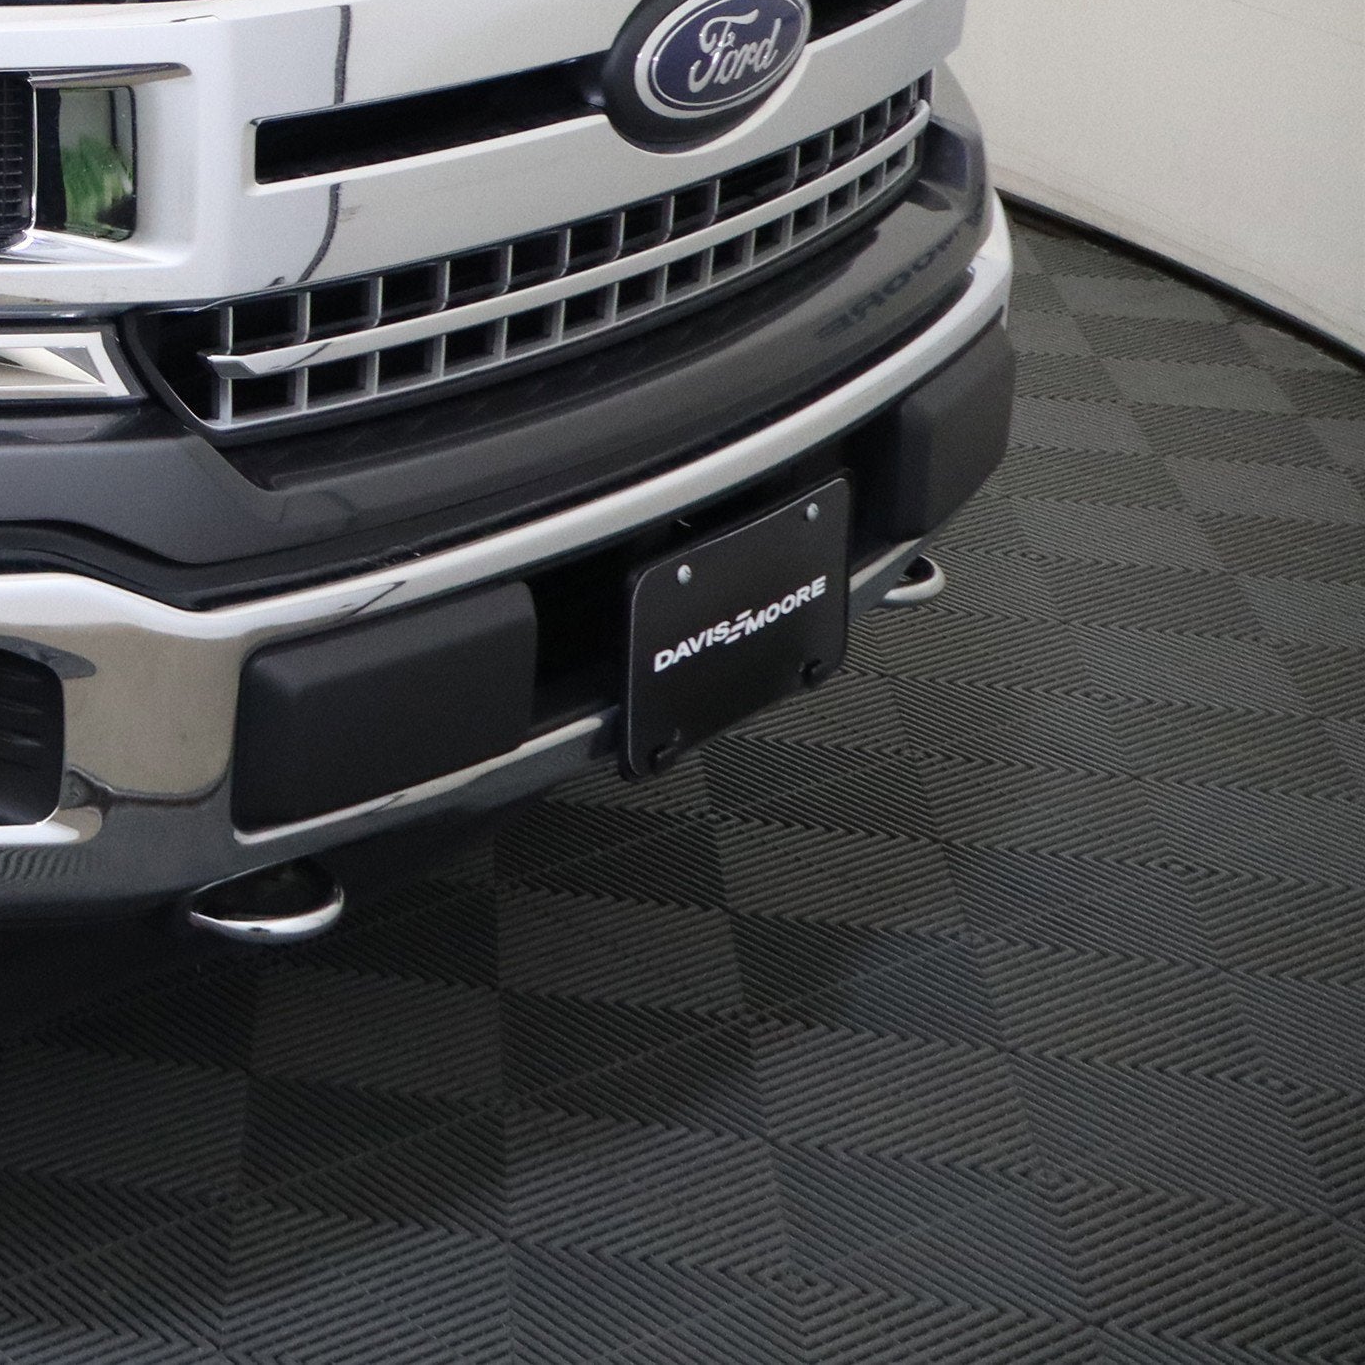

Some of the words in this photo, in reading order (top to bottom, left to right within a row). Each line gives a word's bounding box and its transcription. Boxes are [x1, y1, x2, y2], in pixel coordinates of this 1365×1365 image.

[687, 7, 781, 94] Ford
[653, 620, 731, 673] DAVIS
[744, 575, 827, 636] MOORE
